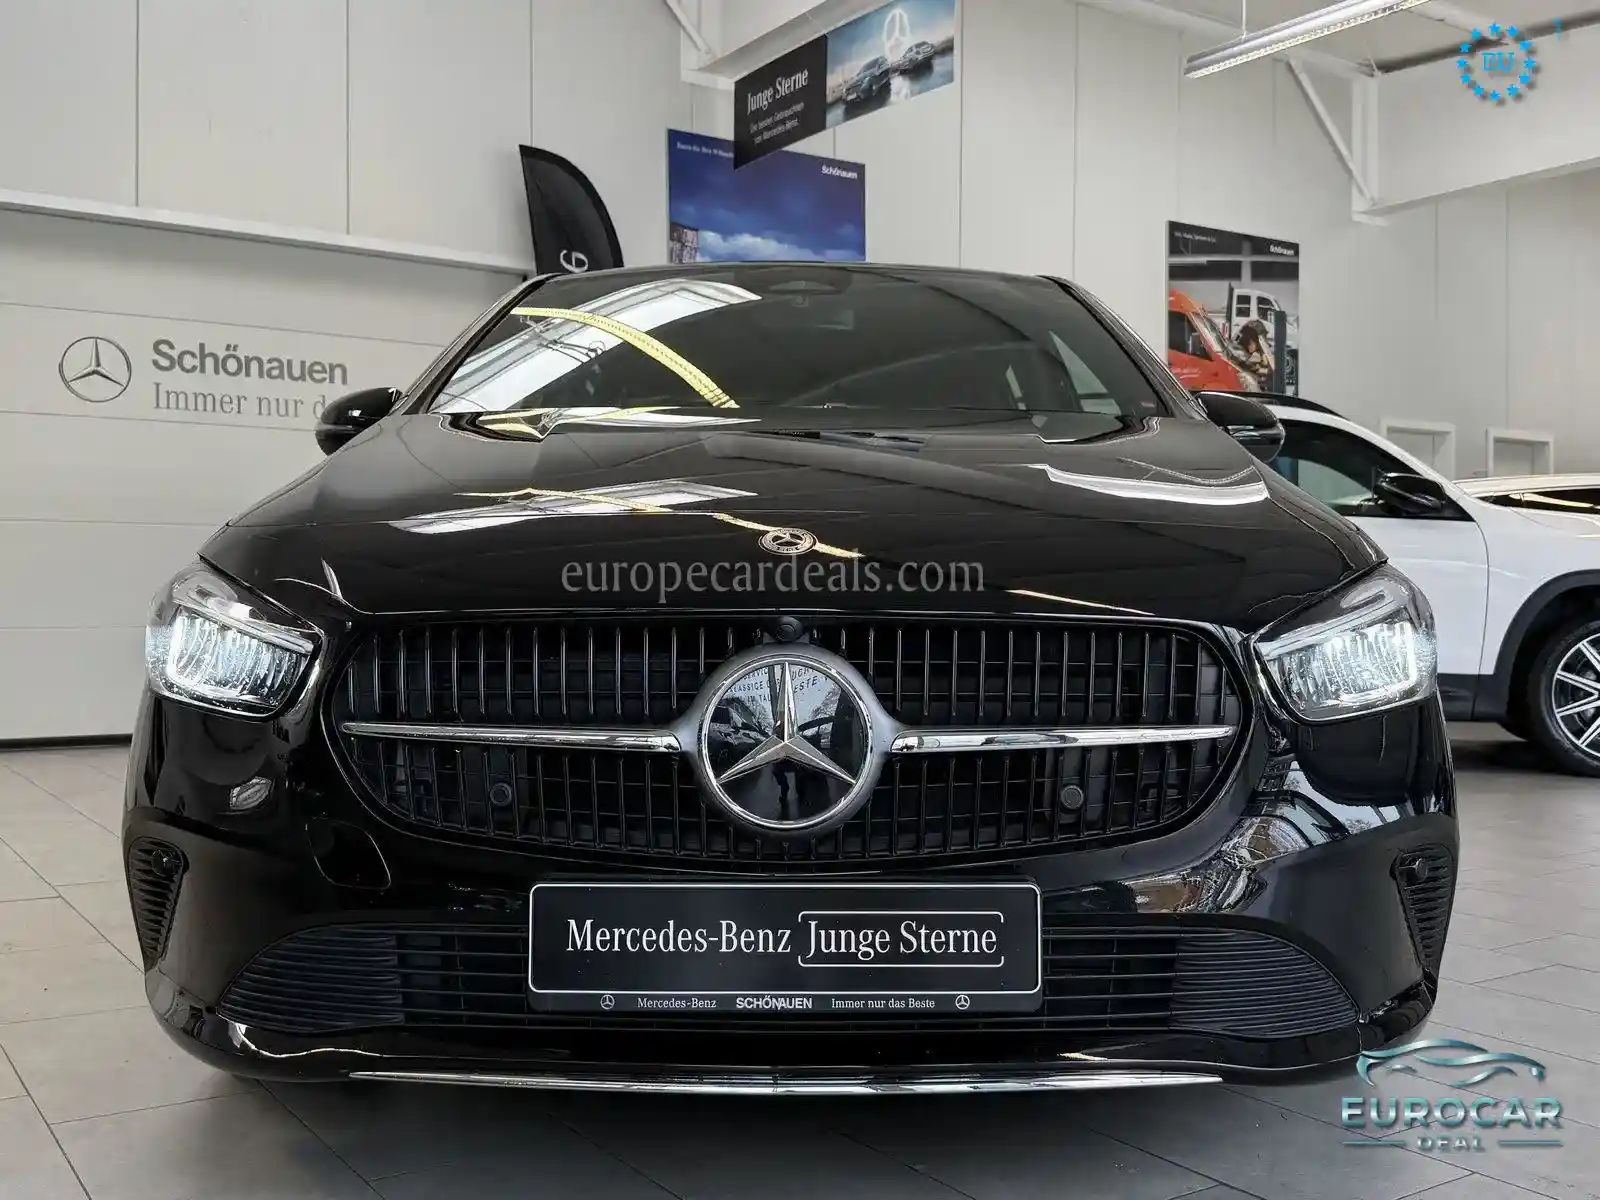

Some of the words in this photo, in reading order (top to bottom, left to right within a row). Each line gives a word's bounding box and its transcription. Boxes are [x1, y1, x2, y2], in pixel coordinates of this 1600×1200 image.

[747, 86, 774, 116] Junge
[775, 68, 809, 99] Sterne
[151, 338, 349, 386] Schönauen
[153, 381, 248, 415] Immer
[256, 395, 304, 419] nur
[566, 918, 792, 953] Mercedes-Benz
[806, 920, 891, 961] Junge
[899, 920, 998, 954] Sterne
[637, 997, 717, 1009] Mercedes-Benz
[736, 994, 813, 1010] SCHÖNAUEN
[831, 997, 864, 1009] Immer
[867, 999, 887, 1009] nur
[888, 997, 906, 1009] das
[908, 997, 936, 1009] Beste
